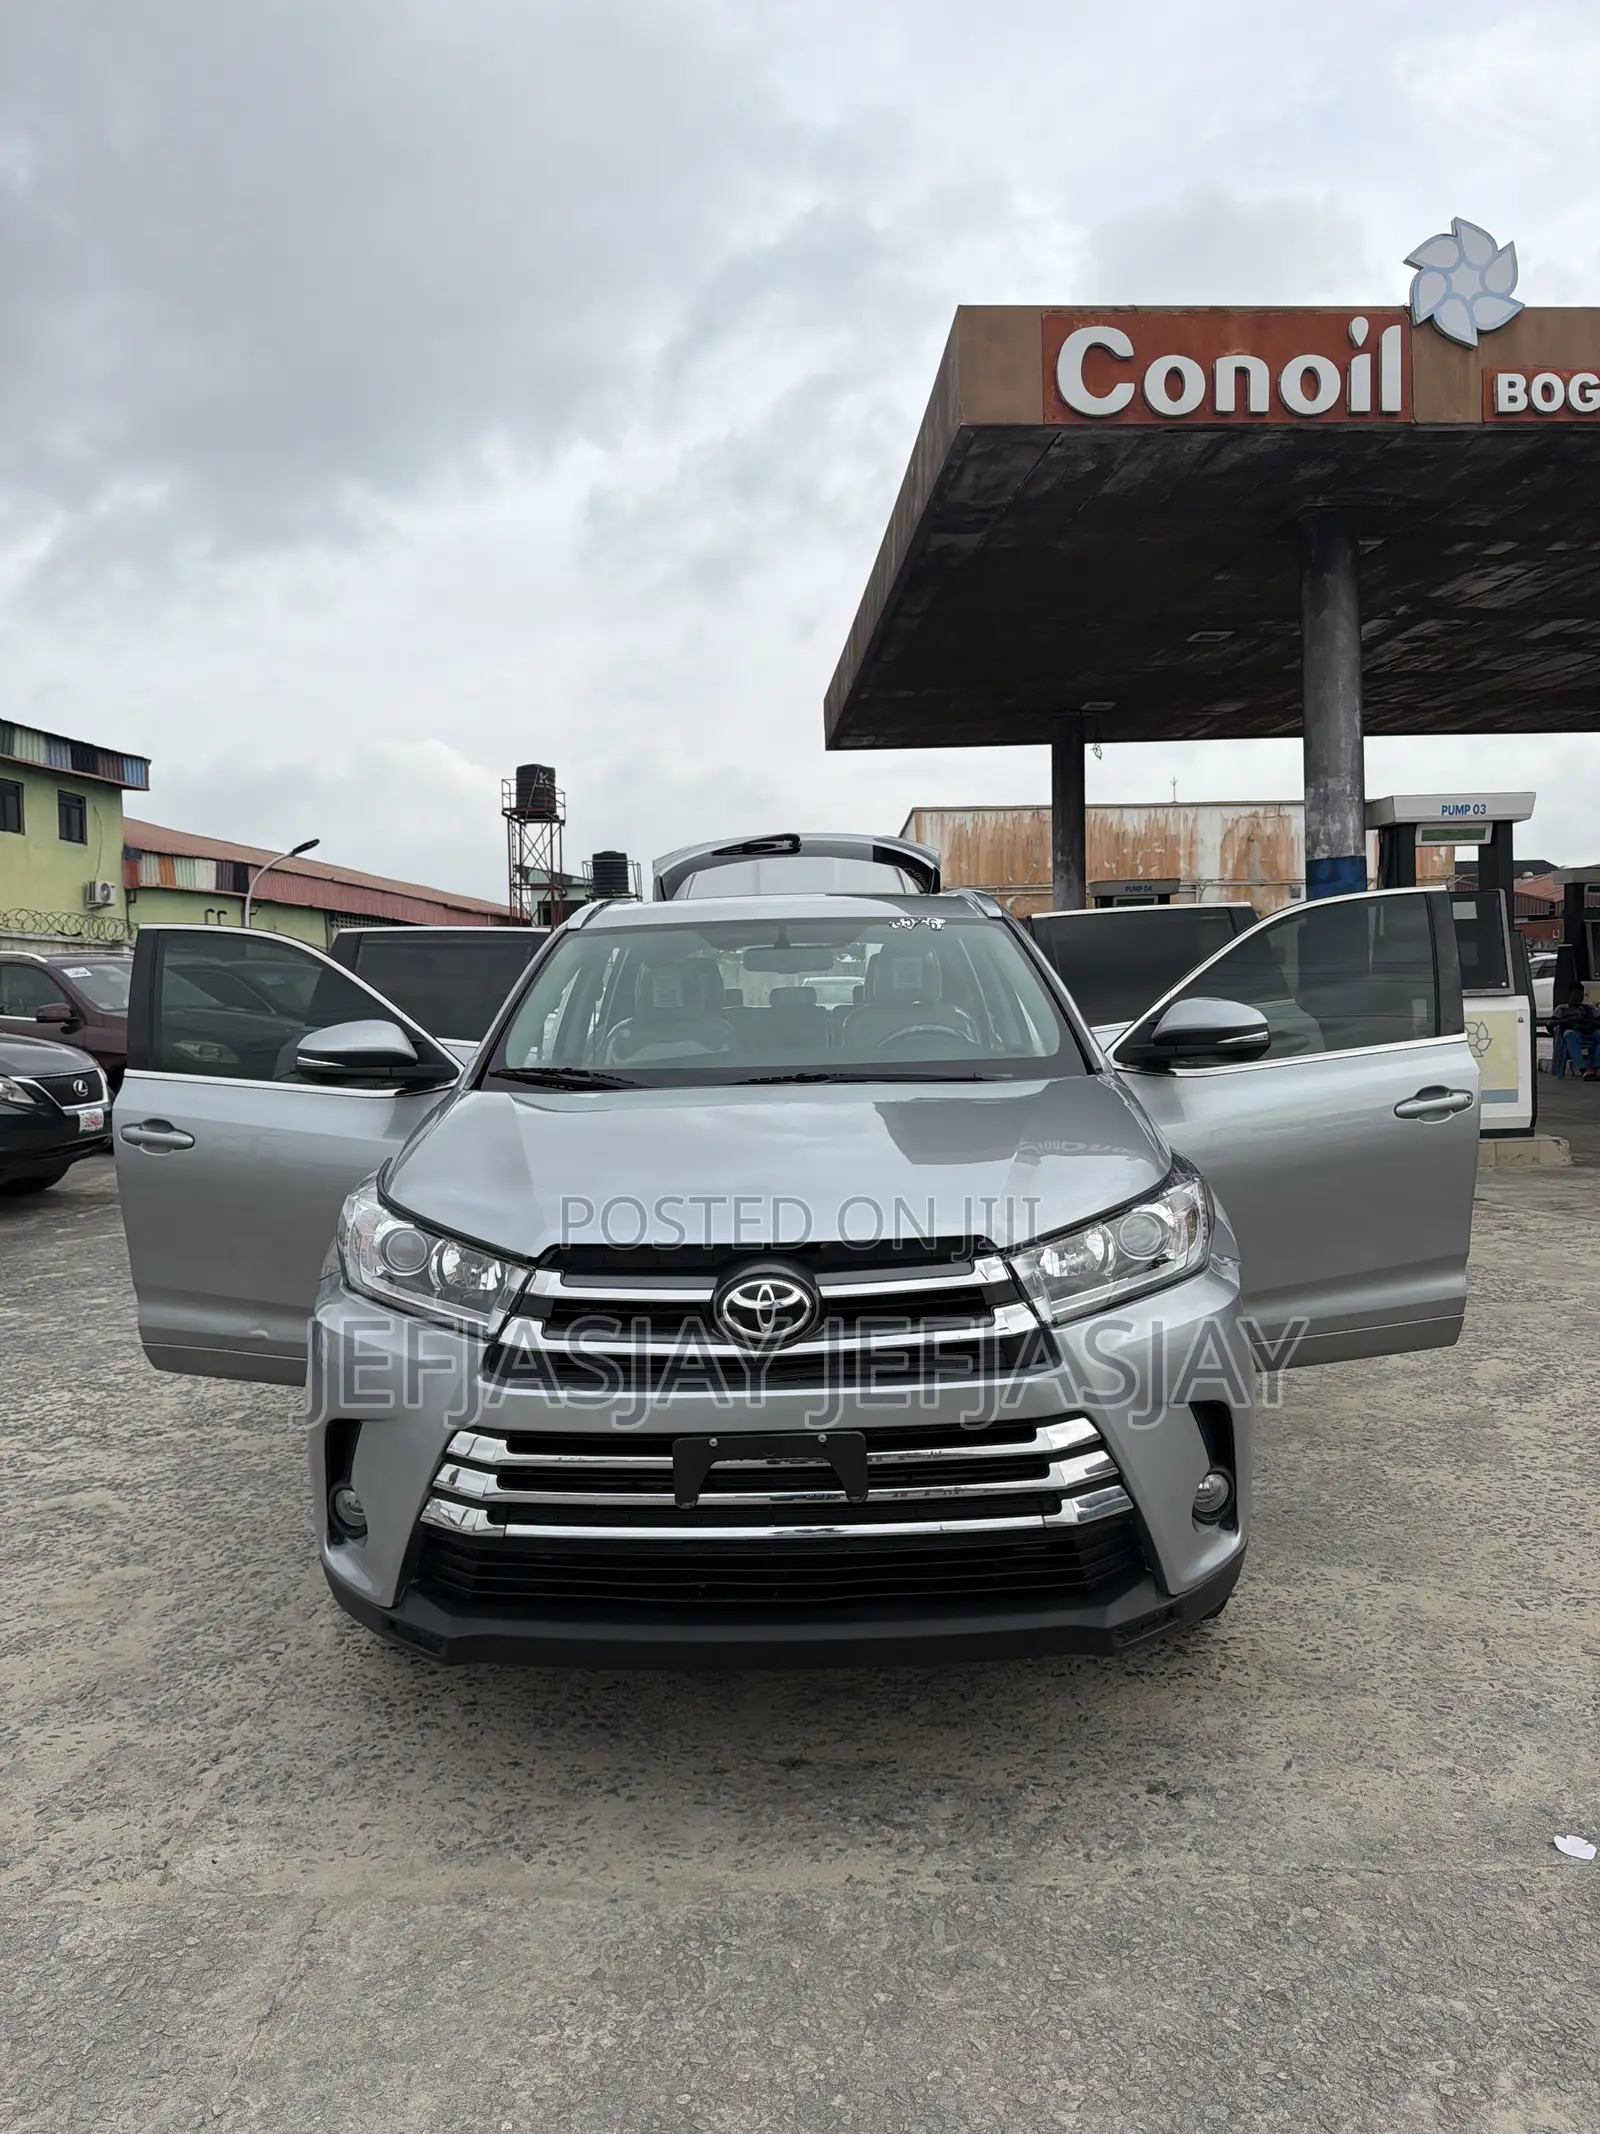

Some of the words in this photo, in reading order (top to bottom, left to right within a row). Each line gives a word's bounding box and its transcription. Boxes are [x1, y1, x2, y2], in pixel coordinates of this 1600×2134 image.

[1056, 316, 1402, 417] Conoil
[1494, 372, 1600, 414] BOG
[1441, 804, 1471, 816] PUMP
[1472, 803, 1487, 815] 03
